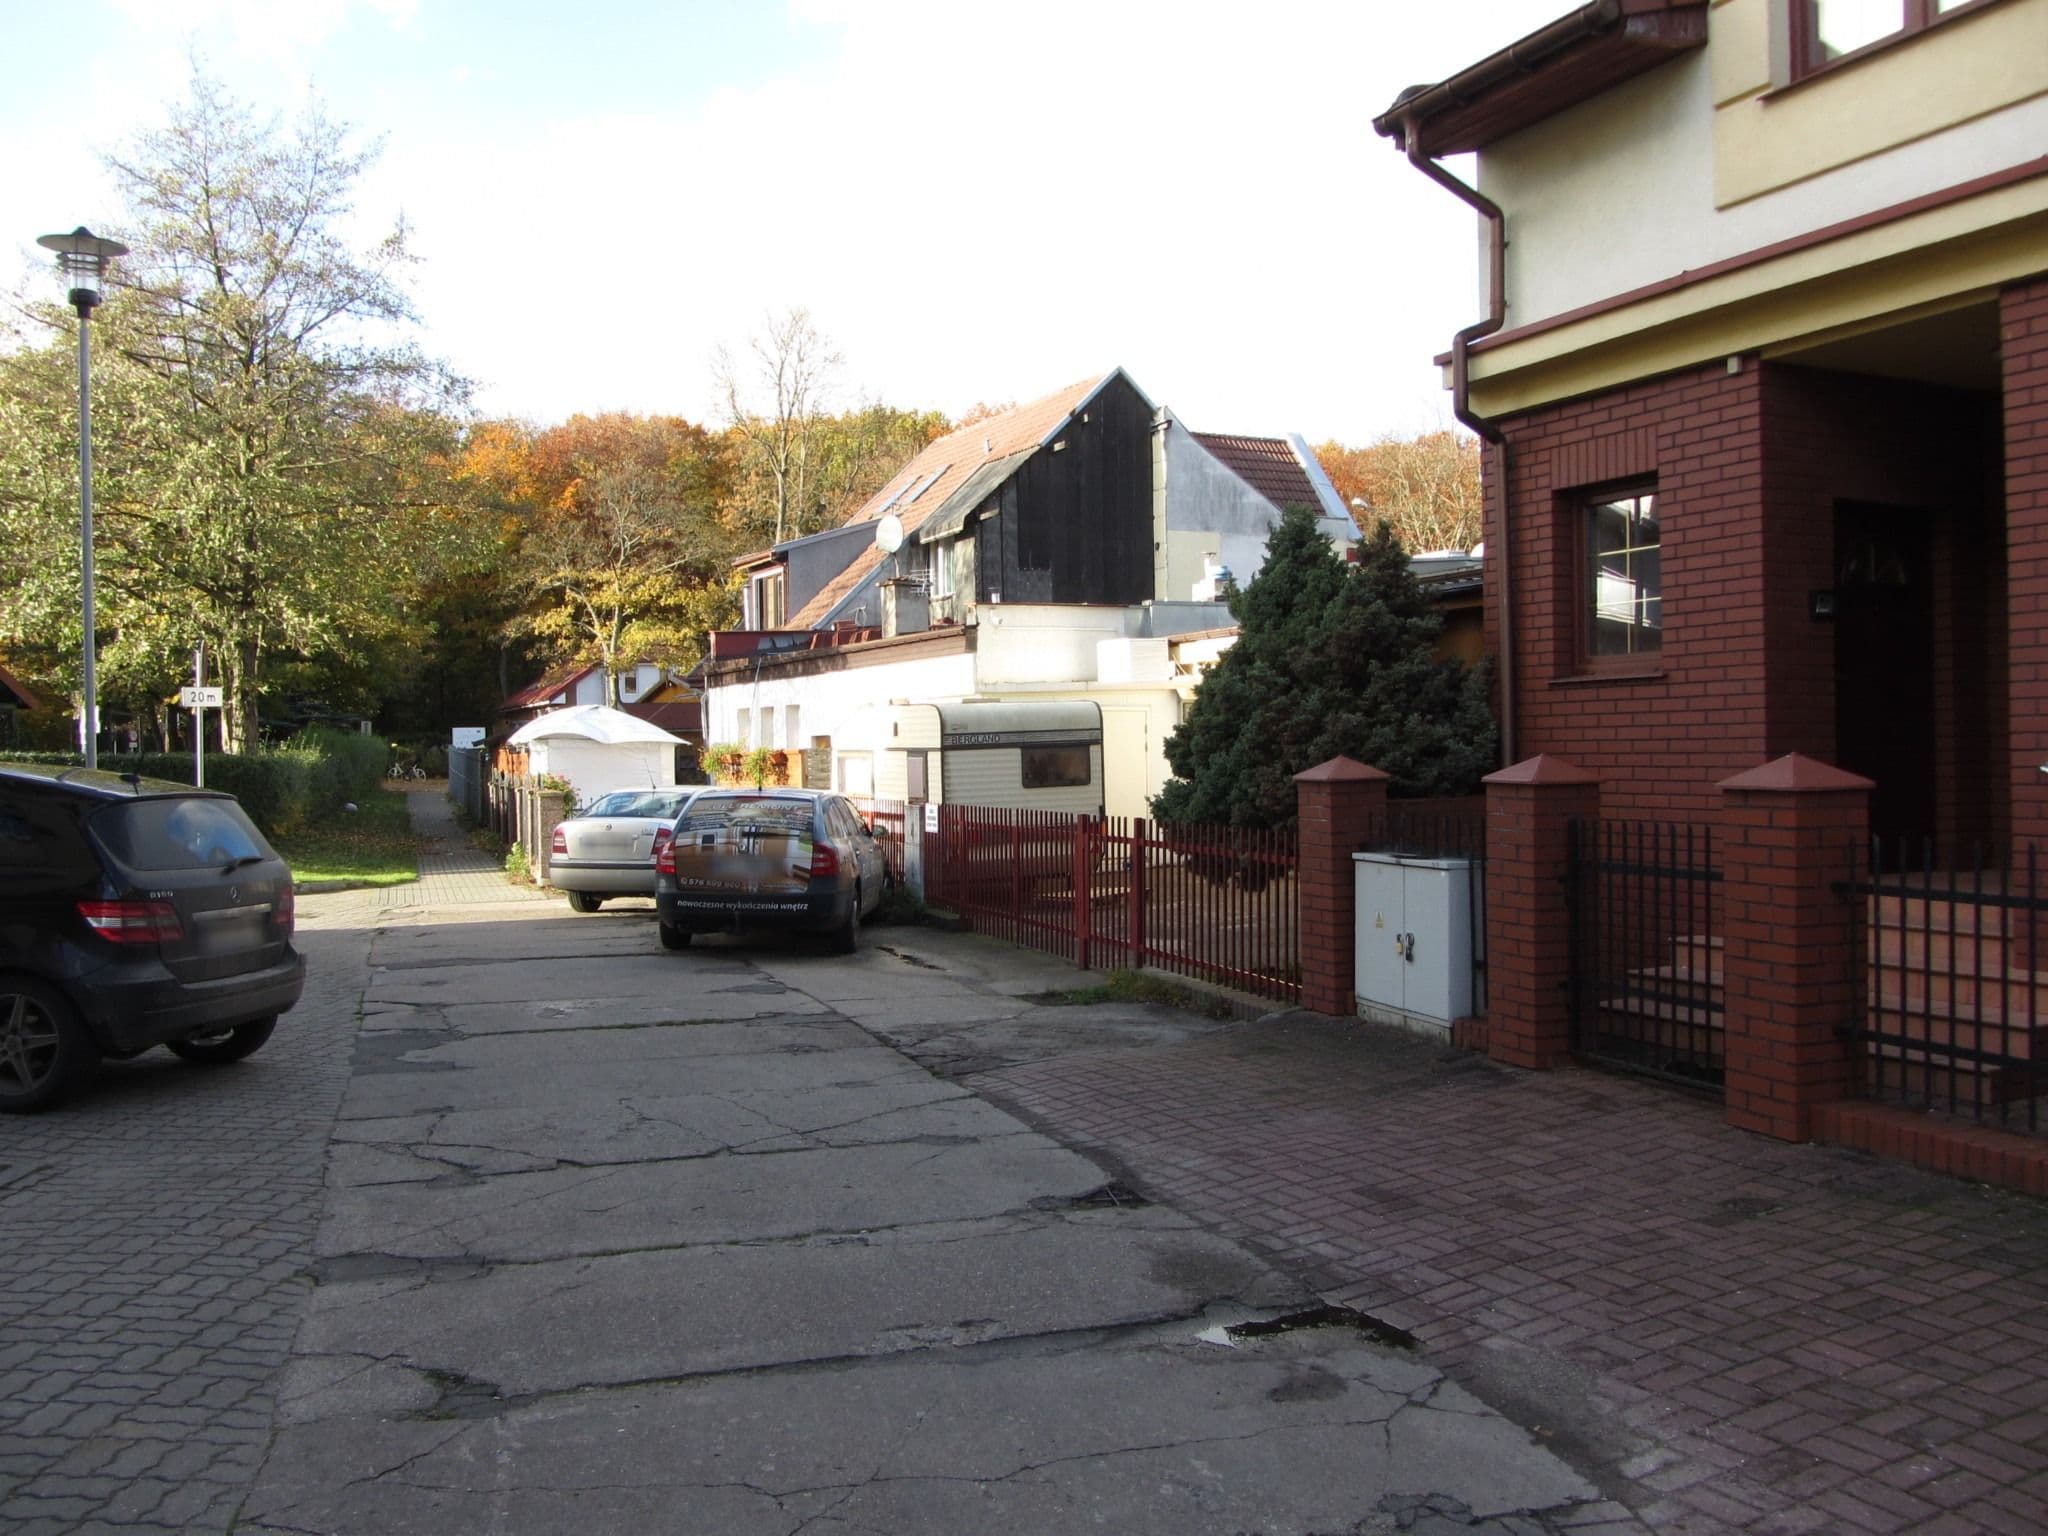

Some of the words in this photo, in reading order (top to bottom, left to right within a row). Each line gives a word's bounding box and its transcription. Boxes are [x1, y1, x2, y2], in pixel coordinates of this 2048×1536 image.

[190, 691, 205, 703] 20
[207, 694, 217, 703] m
[951, 735, 1000, 744] BERGLAND
[677, 899, 725, 910] nowoczesne
[726, 899, 779, 911] wykończenia
[780, 902, 809, 911] wnętrz
